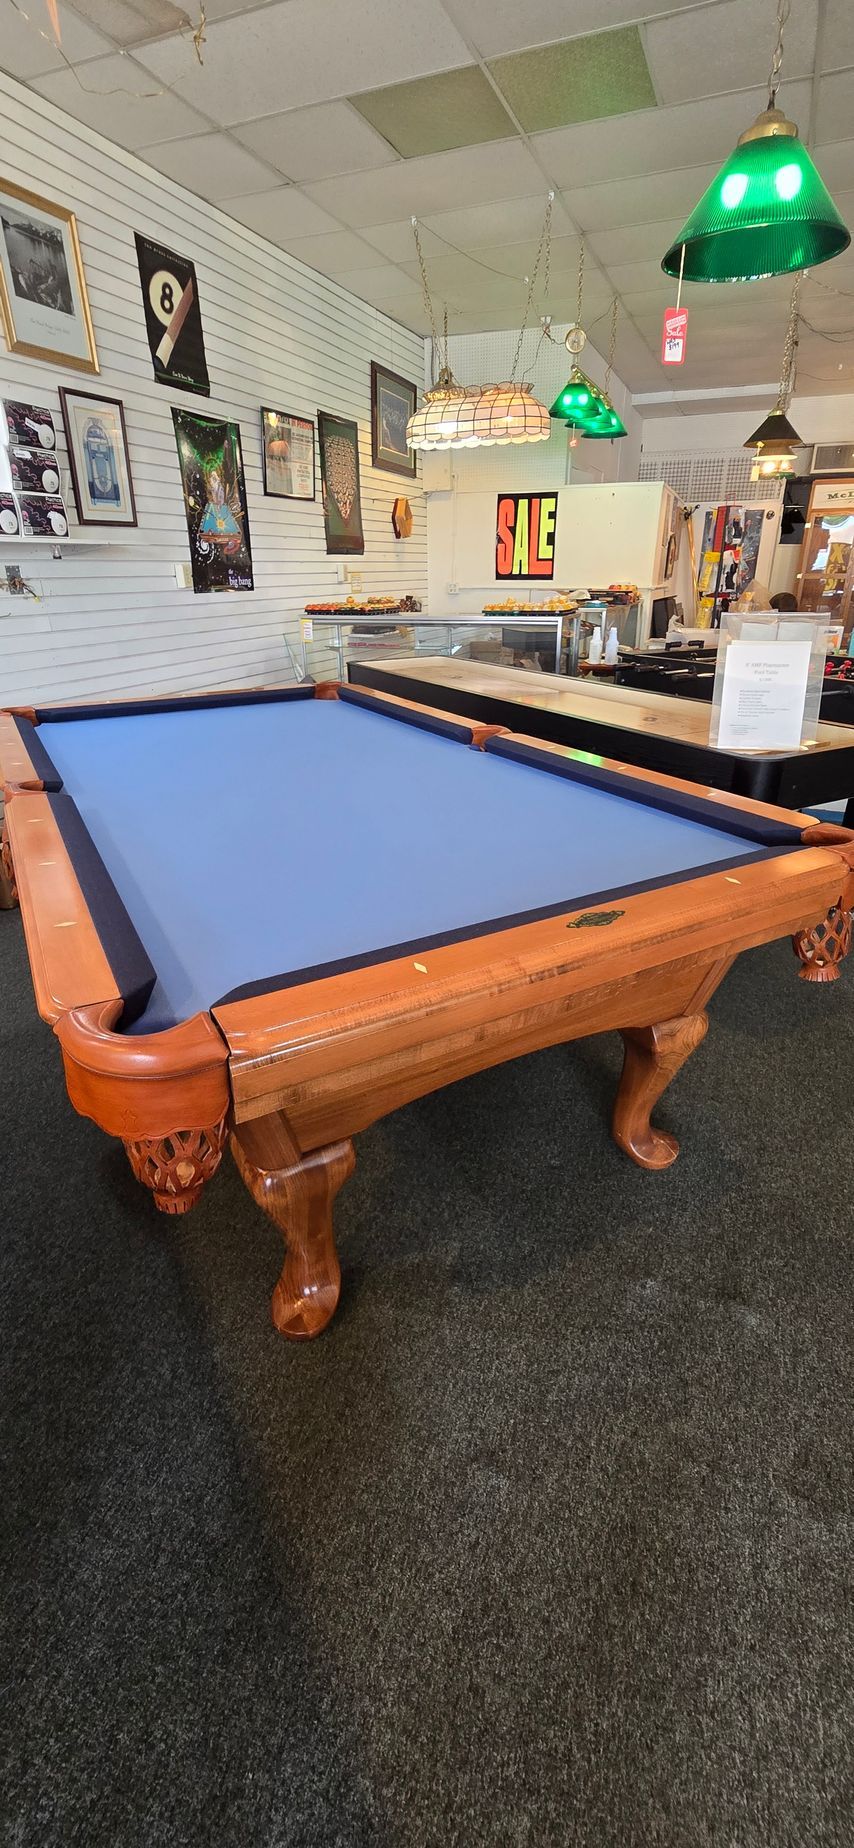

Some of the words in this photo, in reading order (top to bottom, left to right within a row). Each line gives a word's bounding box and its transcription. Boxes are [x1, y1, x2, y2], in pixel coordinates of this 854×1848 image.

[160, 282, 174, 314] 8
[498, 498, 556, 575] SALE
[228, 575, 239, 589] big
[238, 575, 252, 588] bang
